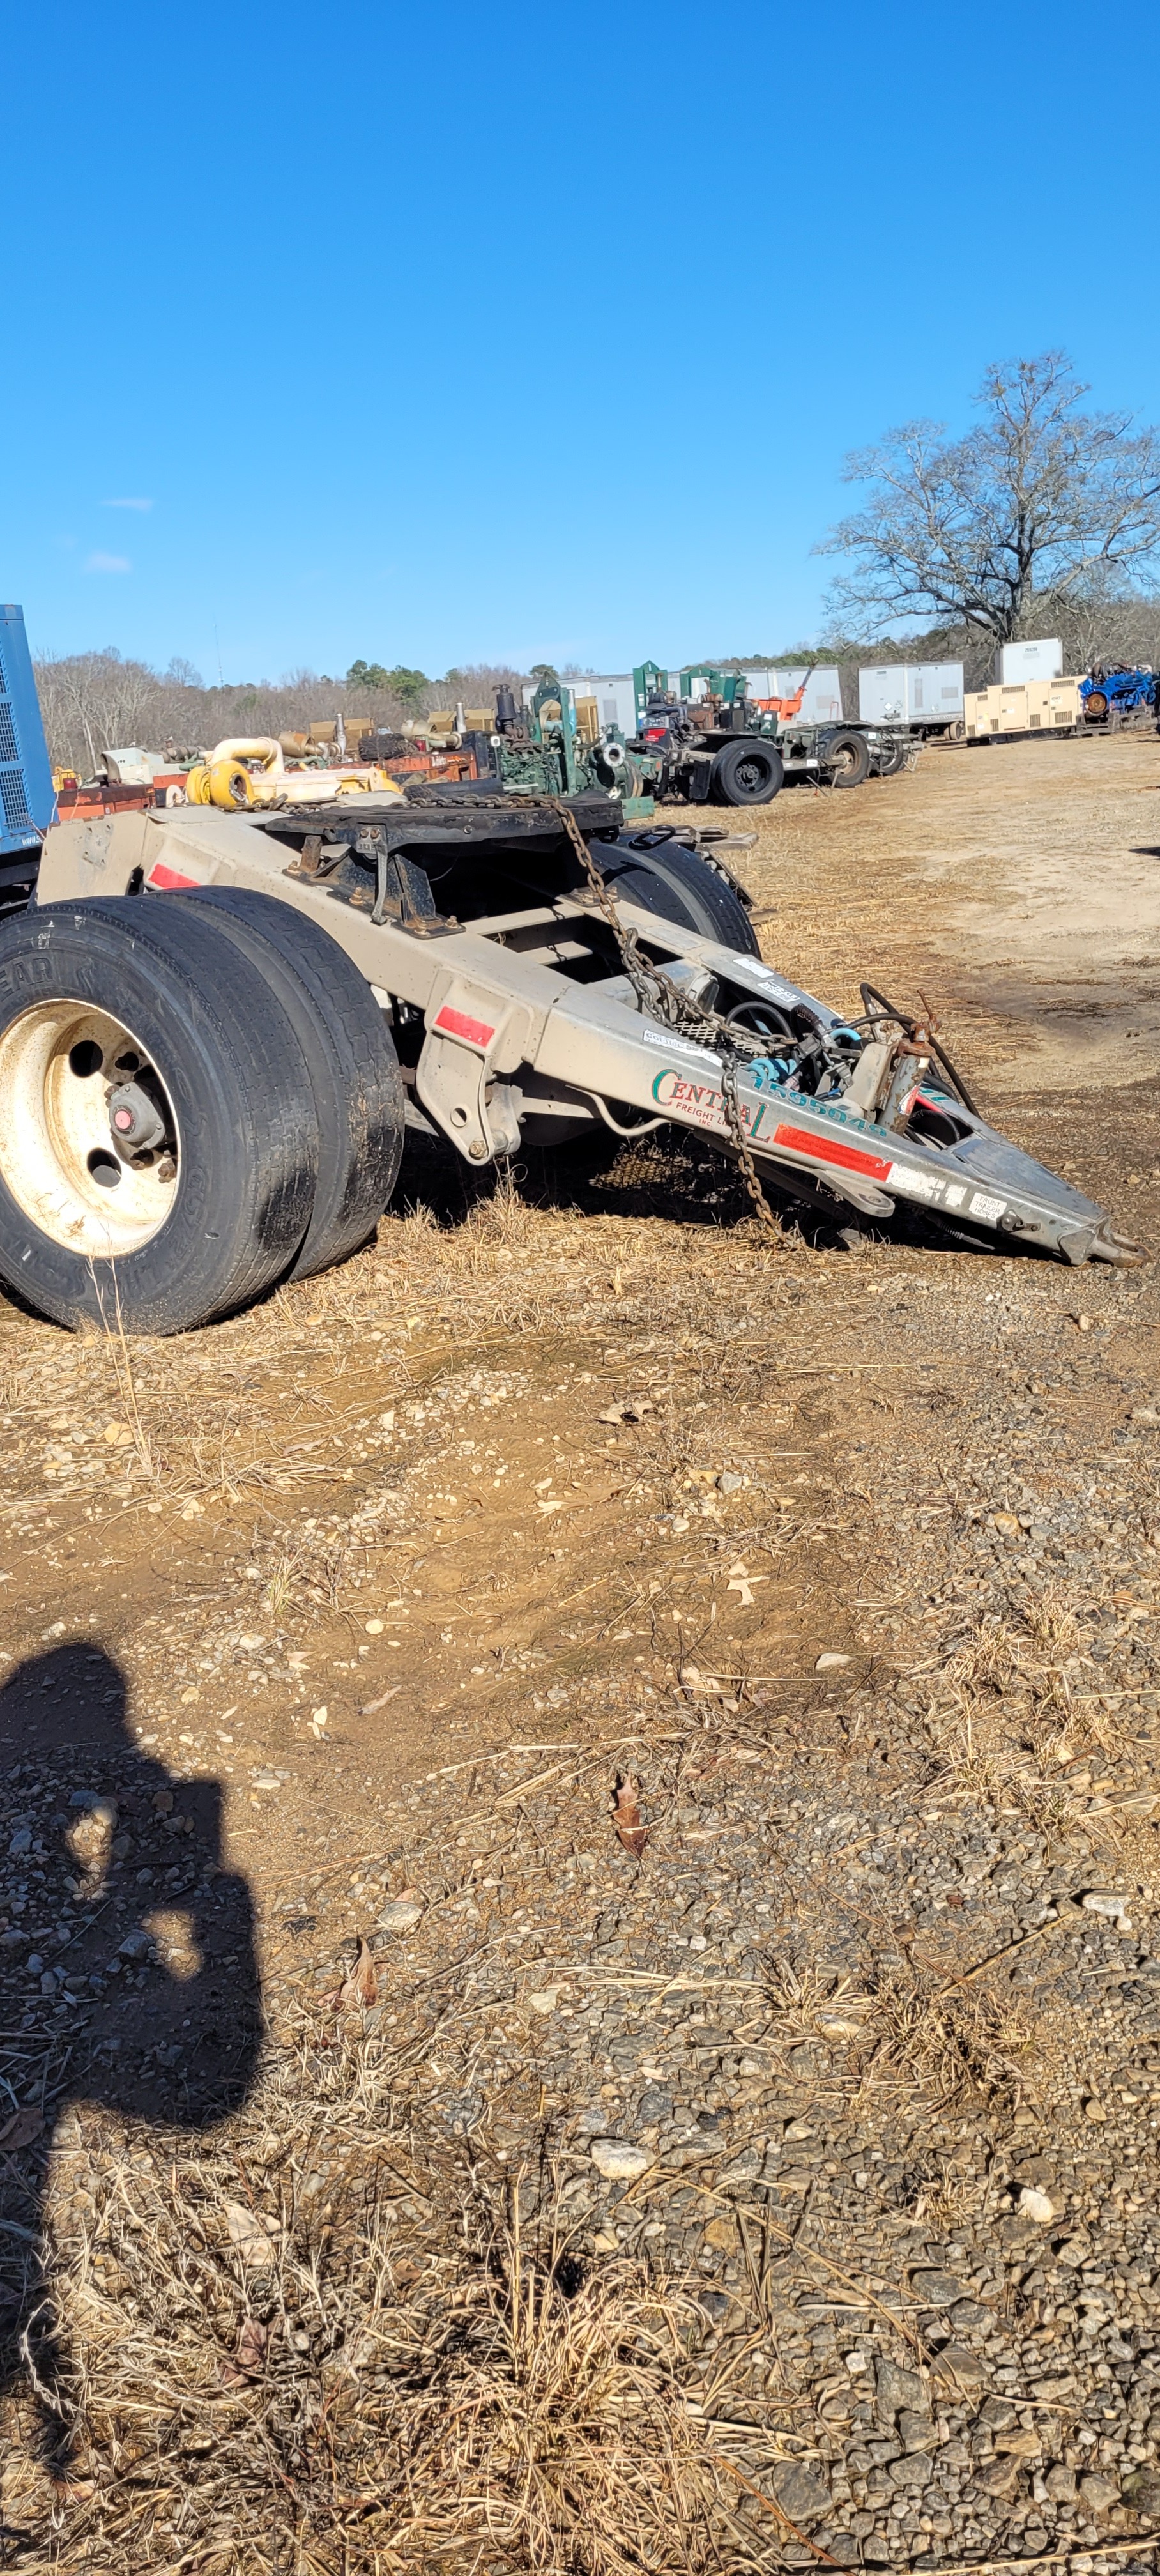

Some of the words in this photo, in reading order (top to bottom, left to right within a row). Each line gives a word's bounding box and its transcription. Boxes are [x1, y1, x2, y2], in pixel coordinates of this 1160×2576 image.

[676, 1102, 715, 1123] FREIGHT
[751, 1075, 887, 1137] 1595049
[699, 1118, 713, 1128] INC.
[975, 1200, 1001, 1215] TRAILER
[979, 1195, 1001, 1207] FRONT
[975, 1208, 996, 1218] HOSES
